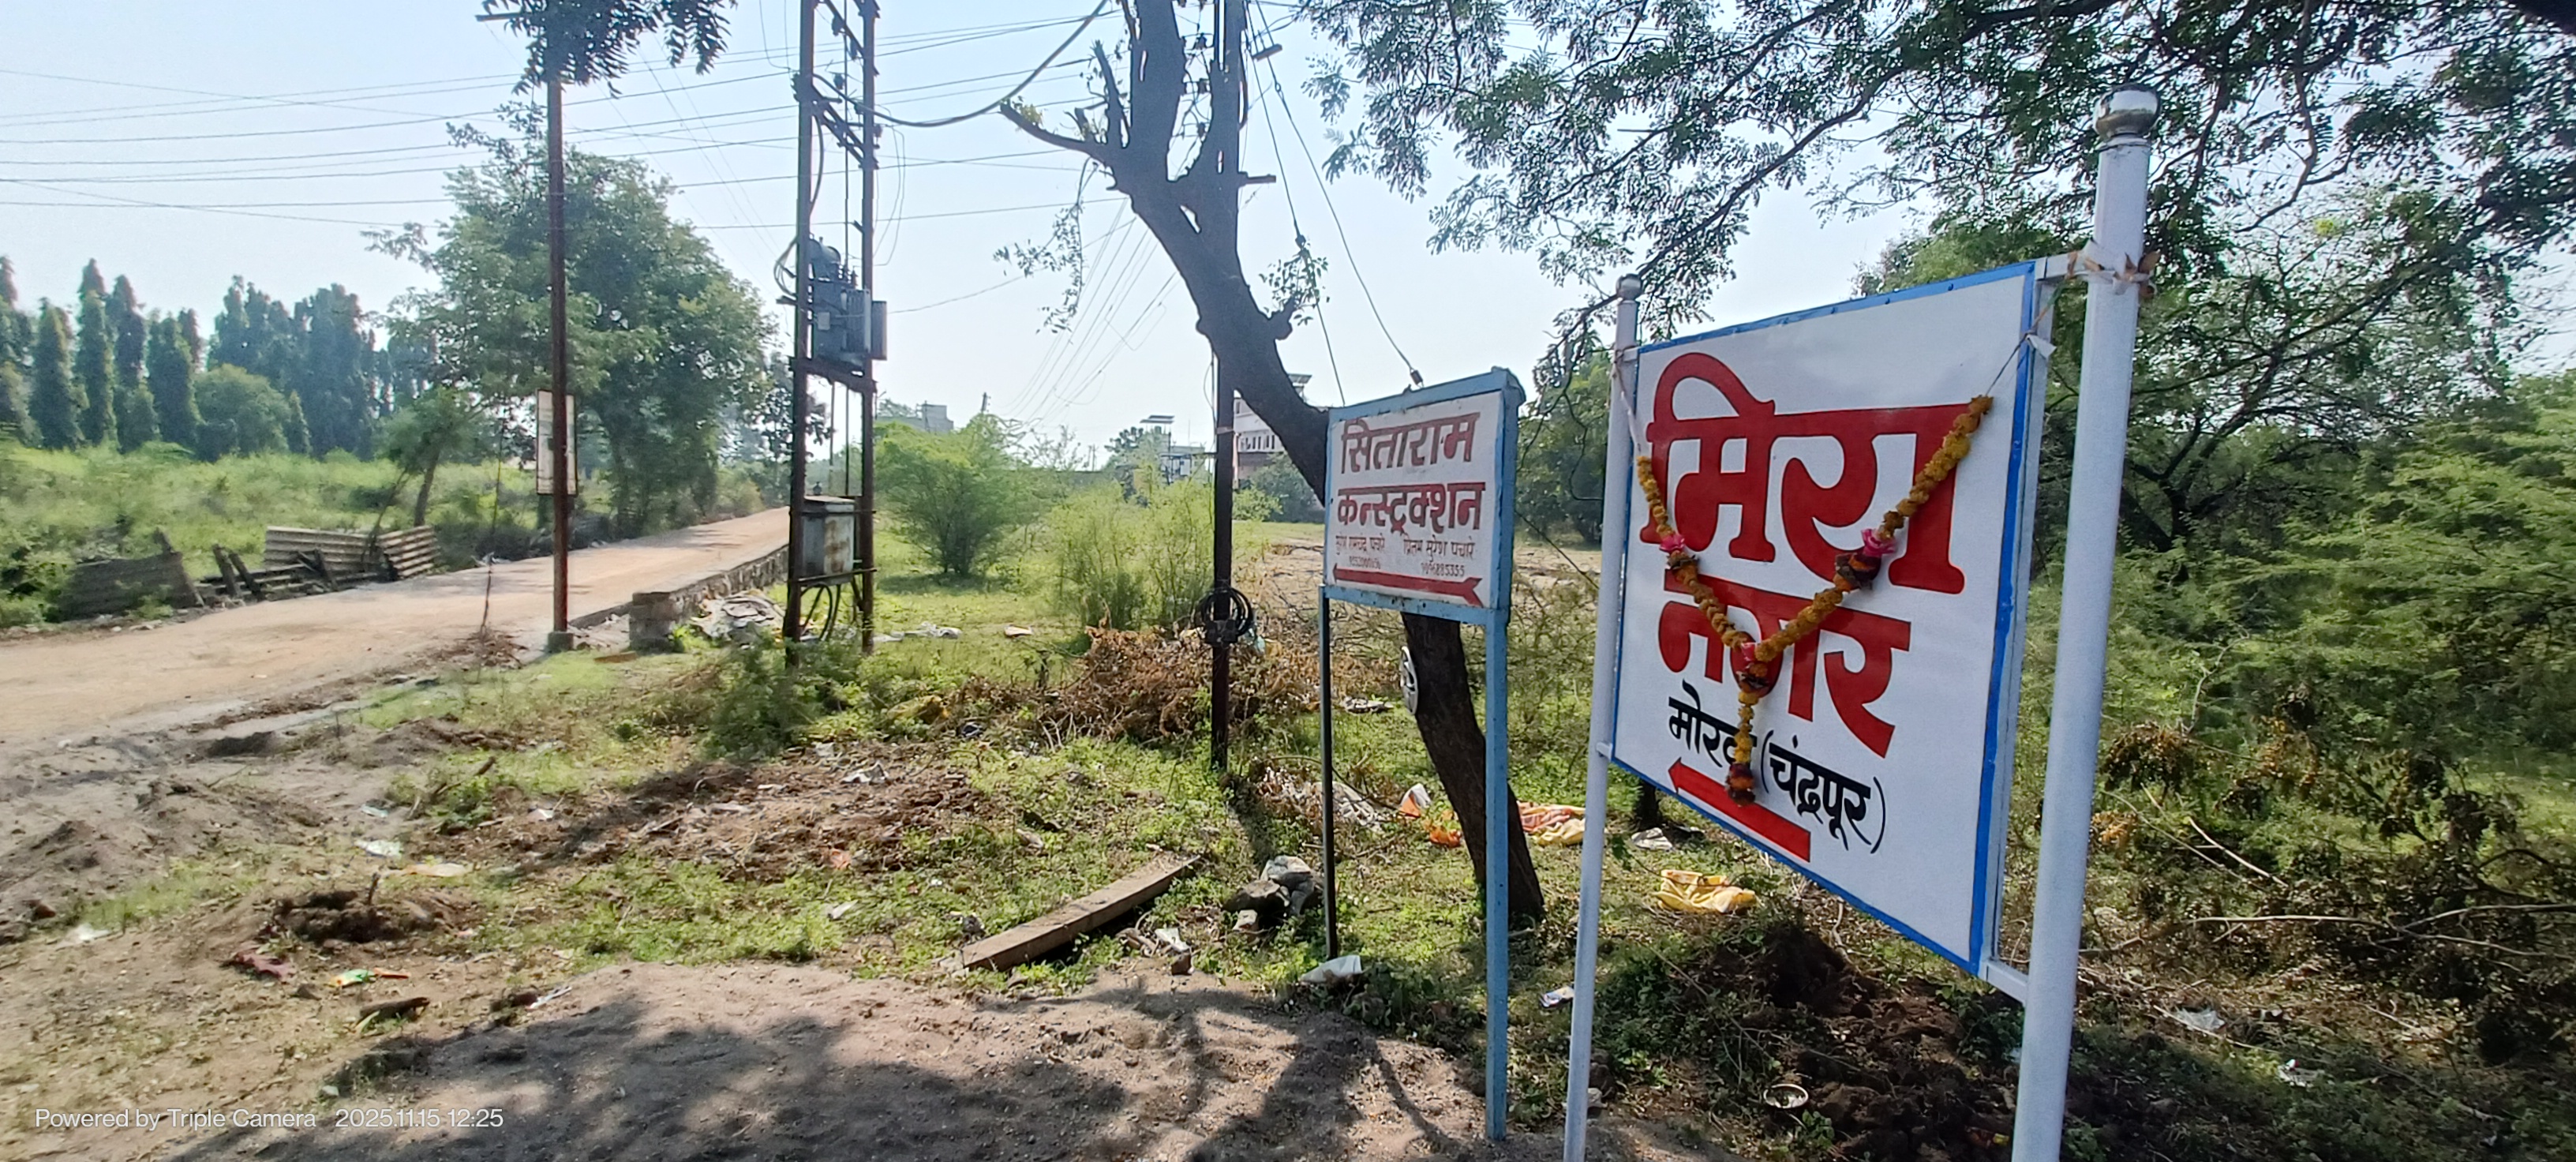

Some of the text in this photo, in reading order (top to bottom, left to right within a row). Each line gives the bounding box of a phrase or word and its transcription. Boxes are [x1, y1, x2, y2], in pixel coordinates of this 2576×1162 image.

[1342, 412, 1480, 474] सिताराम
[1639, 352, 1979, 594] मिरा
[1337, 482, 1485, 534] कन्स्ट्रक्शन
[1658, 568, 1911, 758] नगर
